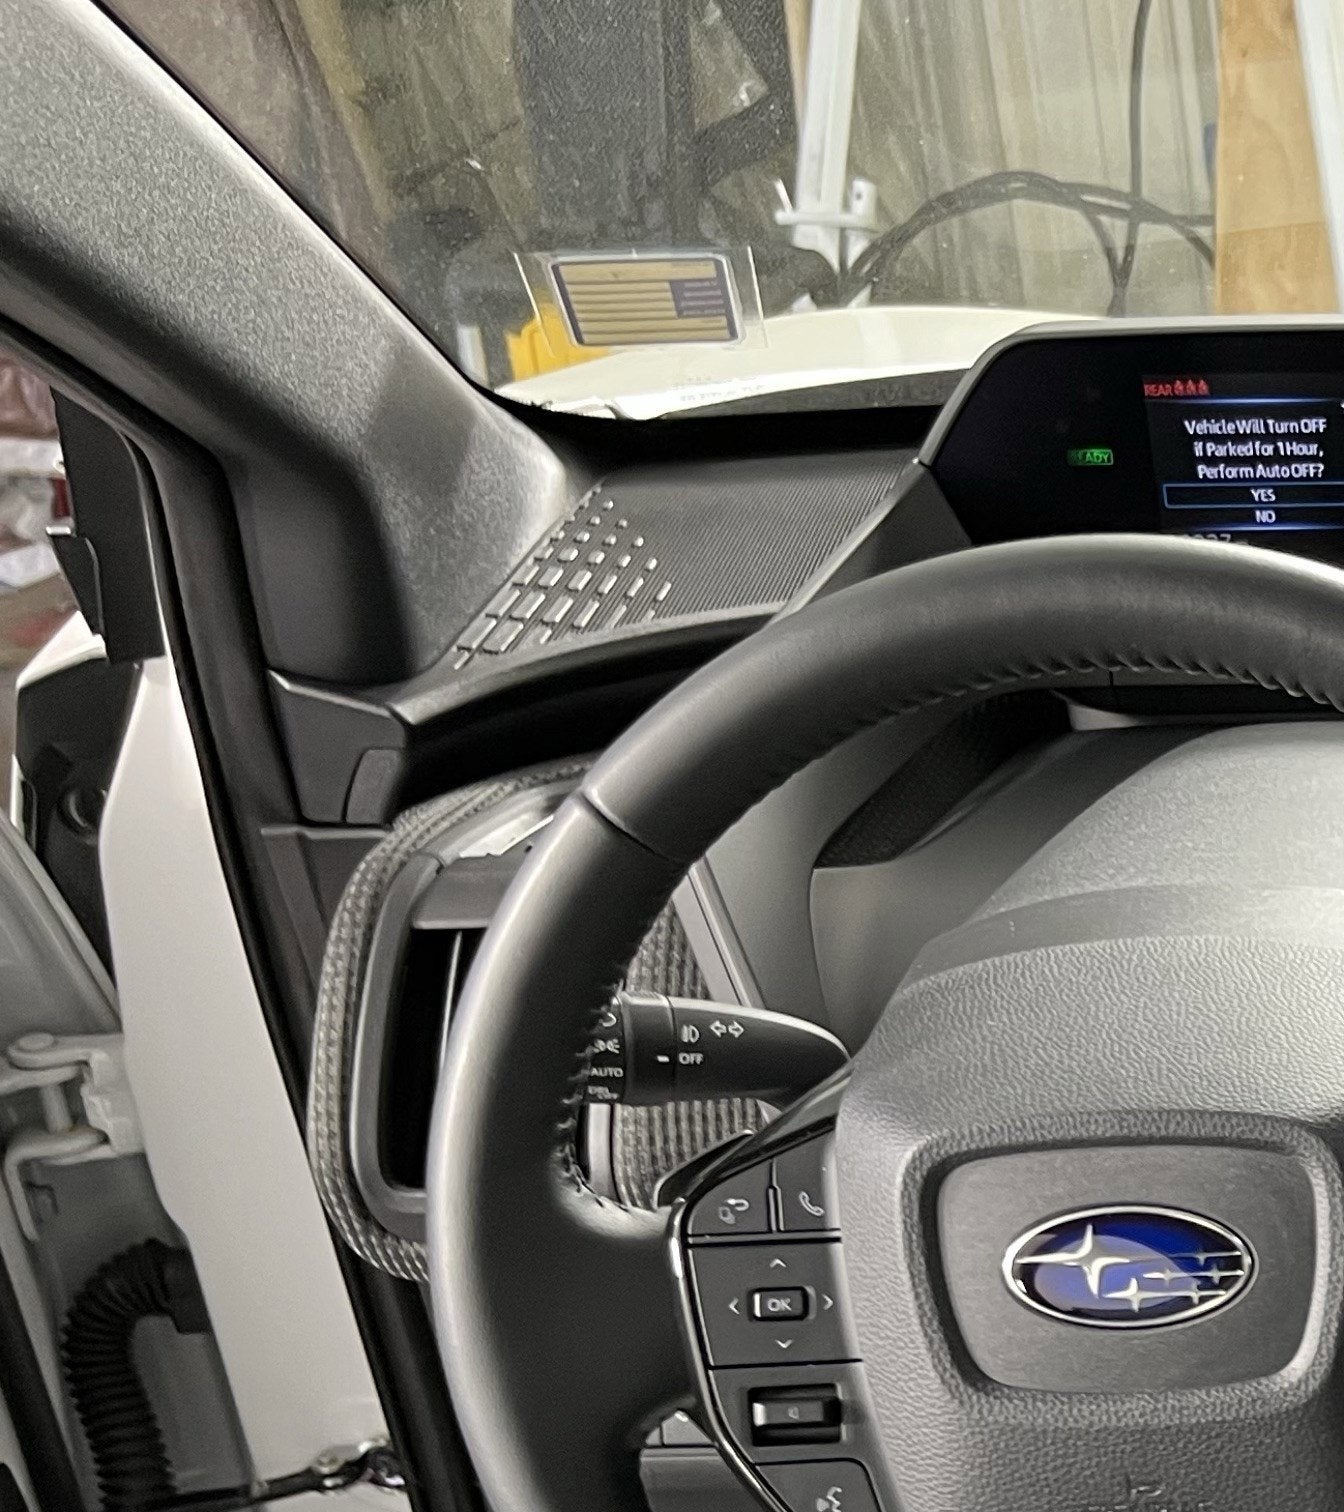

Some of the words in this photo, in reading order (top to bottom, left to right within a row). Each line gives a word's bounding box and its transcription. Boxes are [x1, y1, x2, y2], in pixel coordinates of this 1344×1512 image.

[1184, 418, 1235, 434] Vehicle
[1236, 418, 1265, 434] Will
[1267, 418, 1299, 434] Turn
[1301, 417, 1327, 434] OFF
[1206, 440, 1253, 457] Parked
[1254, 440, 1274, 456] for
[1277, 441, 1285, 455] 1
[1286, 440, 1324, 457] Hour,
[1197, 464, 1255, 479] Perform
[1256, 463, 1290, 479] Auto
[1292, 462, 1325, 478] OFF?
[1251, 487, 1276, 502] YES
[1255, 509, 1276, 523] NO
[590, 1067, 624, 1078] AUTO
[767, 1298, 792, 1313] OK
